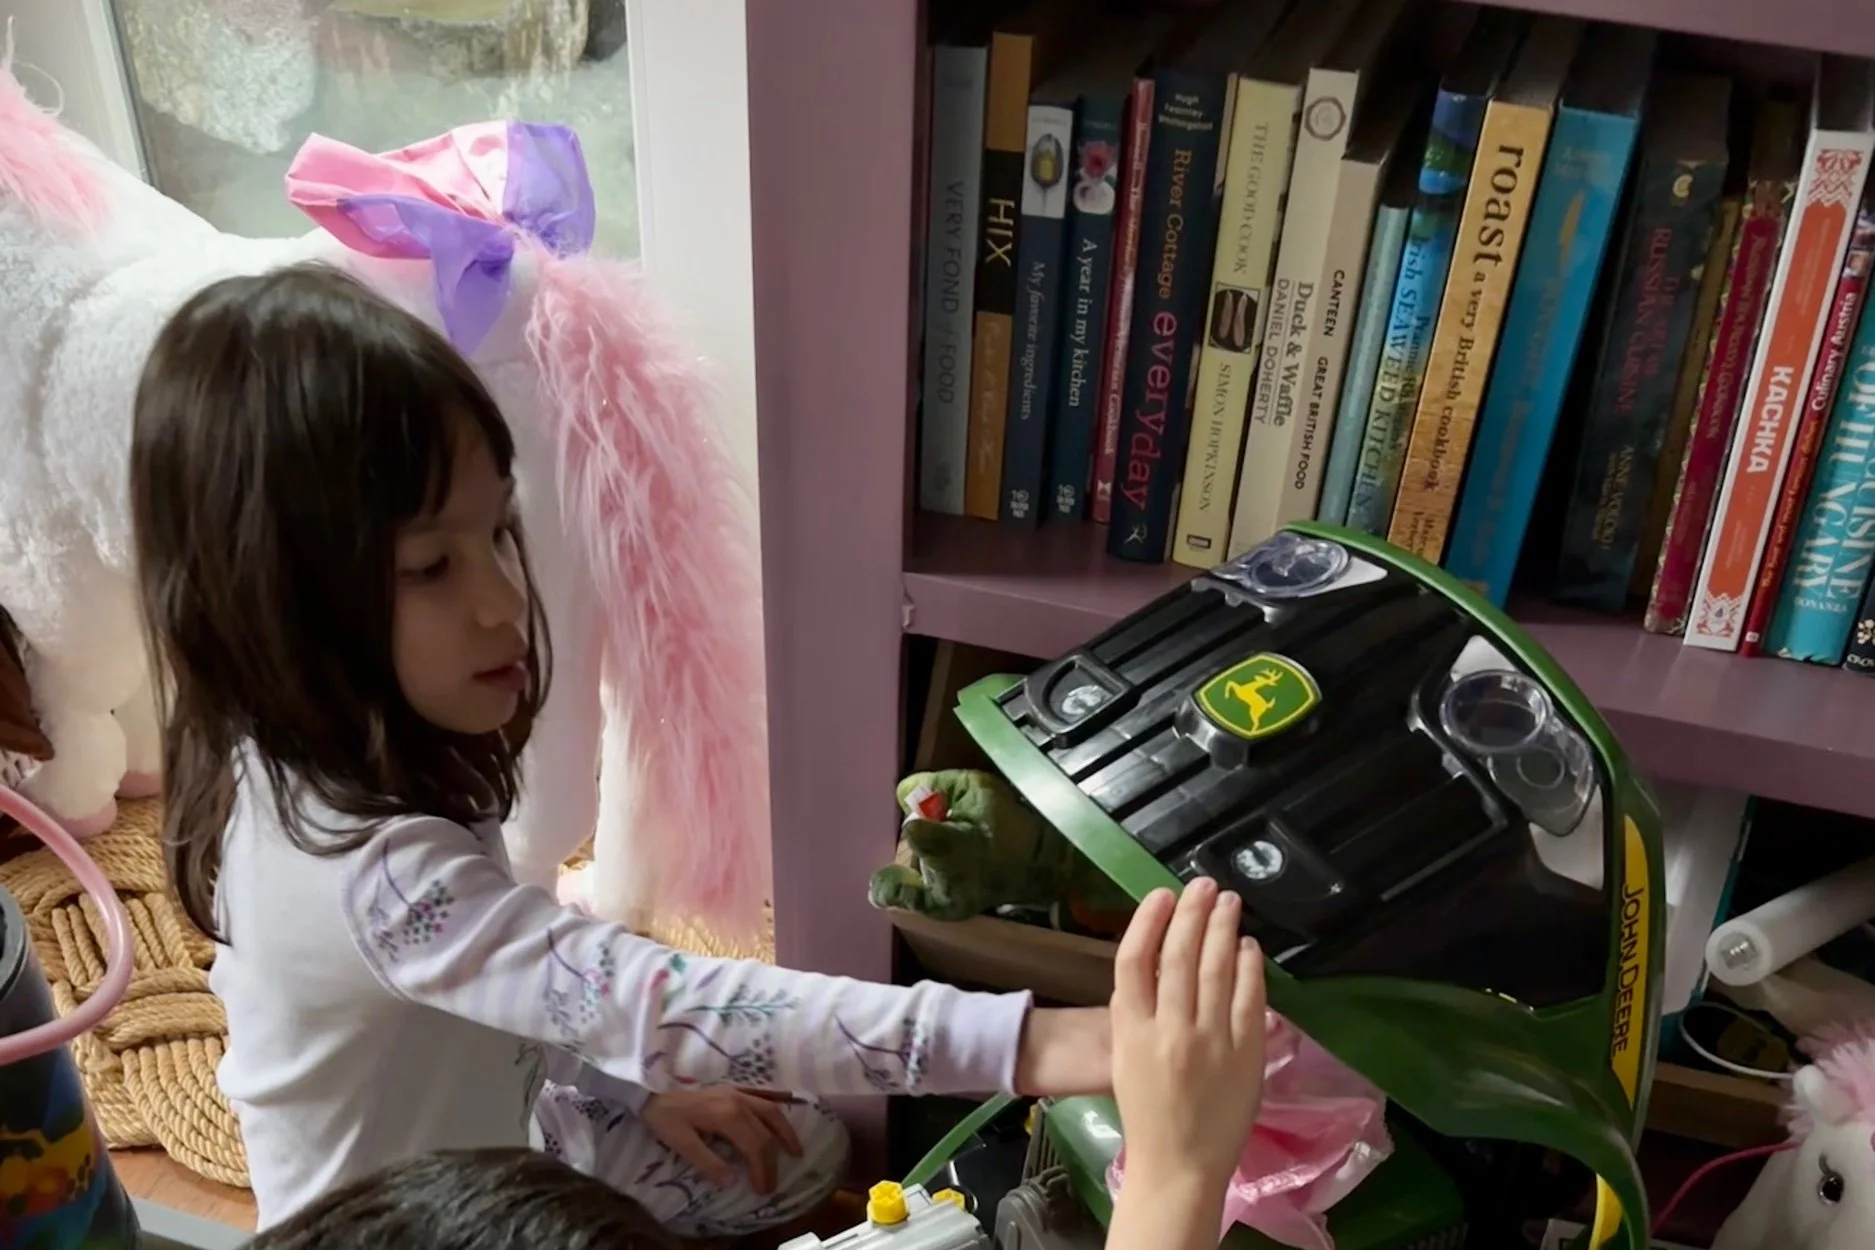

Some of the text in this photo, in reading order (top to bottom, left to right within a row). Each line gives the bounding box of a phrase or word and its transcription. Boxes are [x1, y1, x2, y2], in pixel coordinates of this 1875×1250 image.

[945, 181, 963, 238] VERY
[984, 197, 1015, 268] HIX
[1168, 148, 1193, 207] River
[1233, 122, 1269, 275] THE GOOD COOK
[940, 247, 962, 314] FOND
[1027, 261, 1046, 289] My
[1156, 213, 1184, 299] Cottage
[1423, 145, 1524, 491] roast a very British cookbook
[1613, 226, 1673, 416] RUSSIAN CUISINE
[937, 343, 957, 404] FOOD
[1020, 340, 1040, 421] ingredients
[1068, 238, 1098, 408] A year in my kitchen
[1254, 278, 1290, 425] DANIEL DOHERTY
[1273, 281, 1314, 428] Duck & Waffle
[1294, 269, 1346, 491] CANTEEN GREAT BRITISH FOOD
[1379, 286, 1418, 403] SEAWEED
[1811, 347, 1846, 412] Culinary
[1829, 290, 1858, 347] Austria
[1121, 311, 1178, 510] everyday
[1199, 362, 1231, 512] SIMON HOPKINSON
[1355, 409, 1391, 508] KITCHEN
[1745, 365, 1794, 474] KACHKA
[1792, 419, 1875, 596] HUNGARY
[1825, 455, 1875, 600] ISINE
[1612, 884, 1645, 1058] JOHN DEERE
